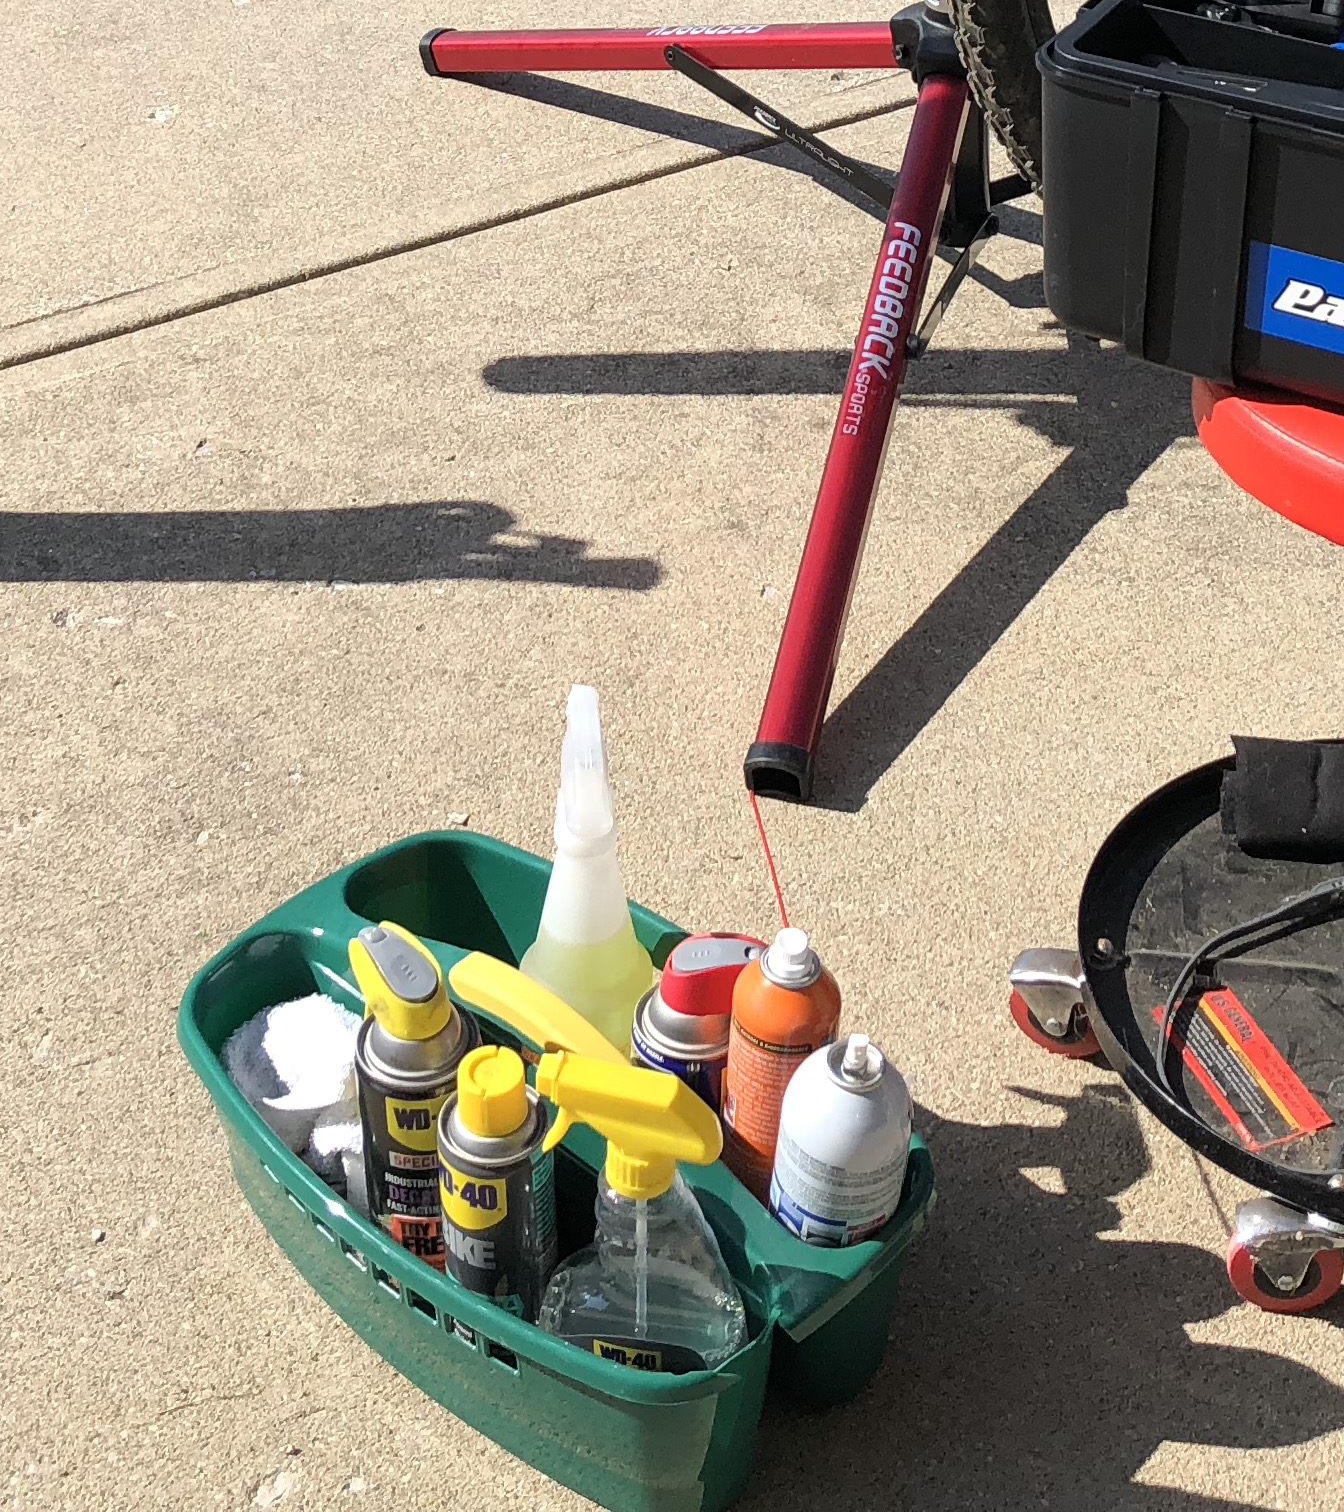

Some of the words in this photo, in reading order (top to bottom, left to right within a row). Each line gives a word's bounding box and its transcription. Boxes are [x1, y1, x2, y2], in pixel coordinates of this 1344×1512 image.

[783, 128, 855, 177] ULTRALIGHT
[857, 221, 923, 381] FEEDBACK
[842, 371, 872, 436] SPORTS
[393, 1107, 438, 1131] WD-
[393, 1154, 438, 1169] SPECI
[384, 1171, 439, 1189] INDUSTRIAL
[386, 1198, 442, 1215] FAST-ACTIN
[389, 1184, 440, 1206] DEGR
[403, 1235, 447, 1256] FRE
[599, 1343, 657, 1371] WD-40
